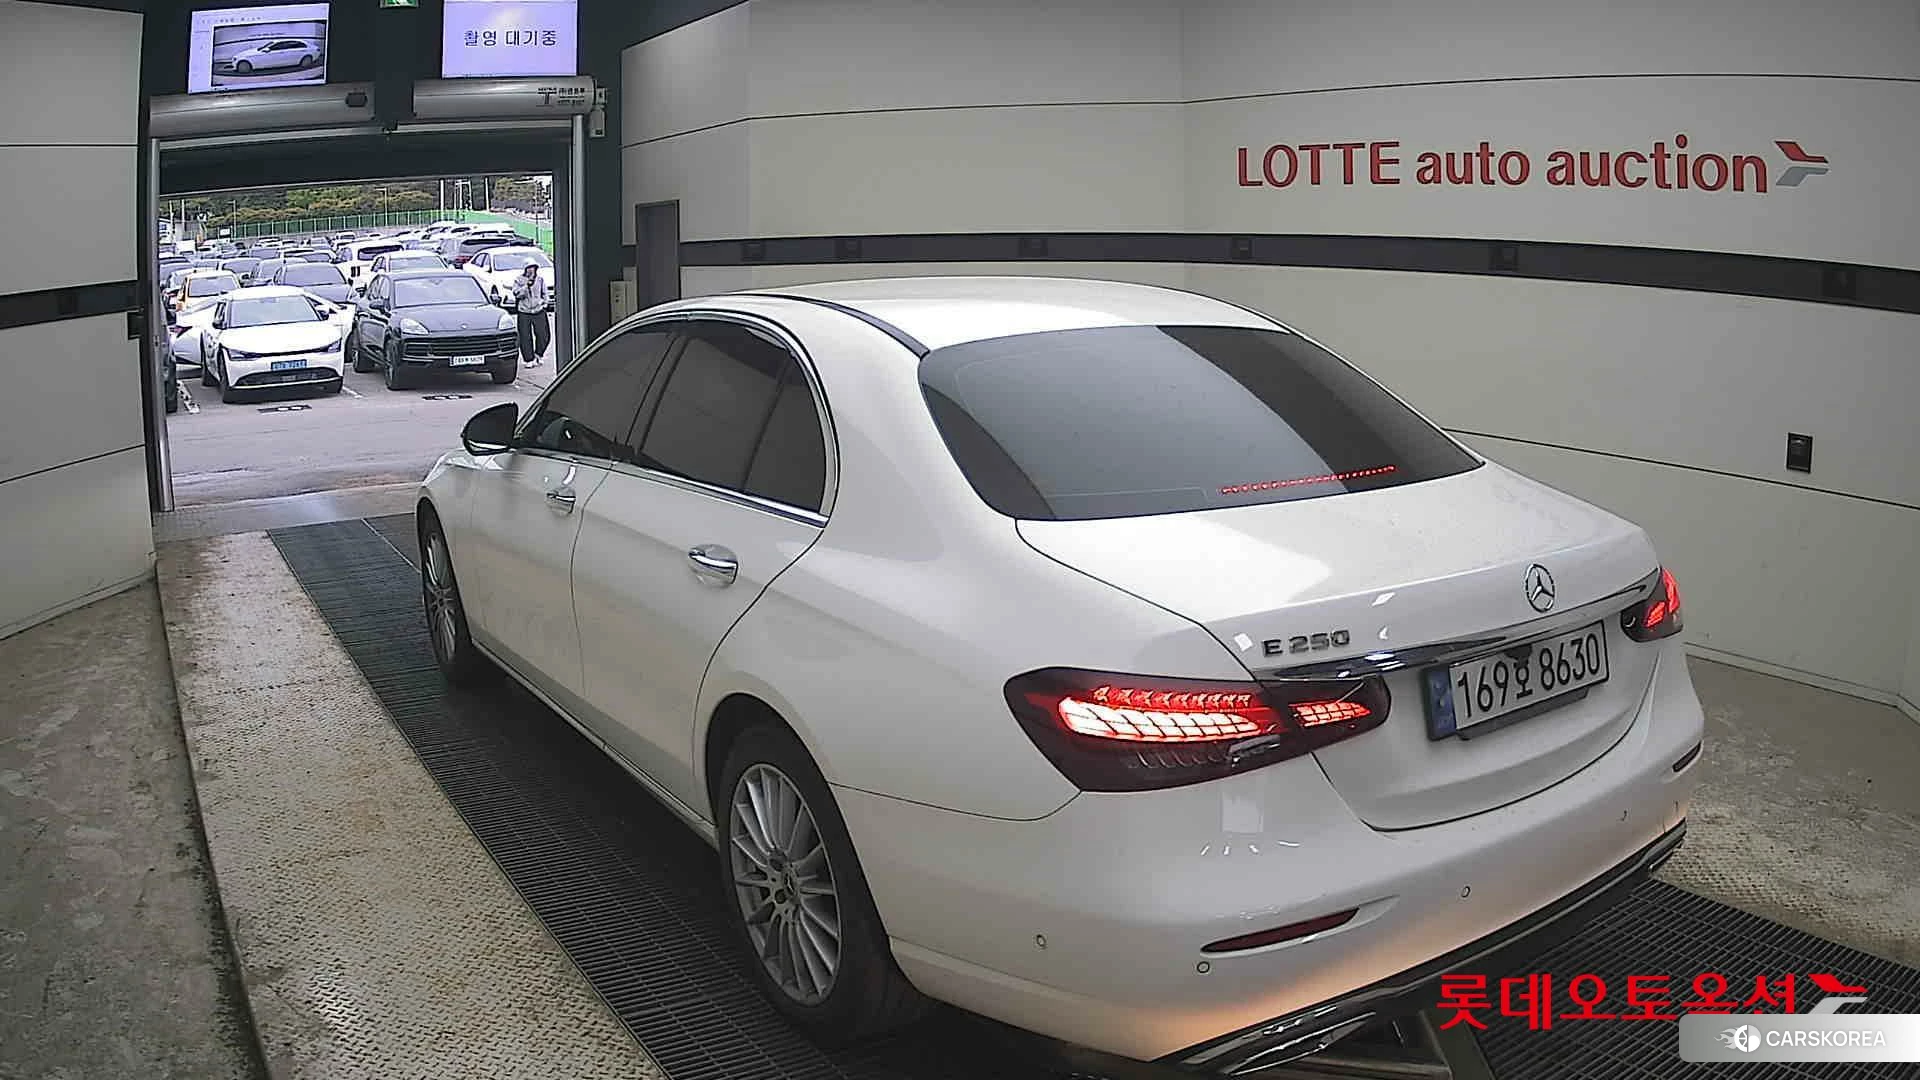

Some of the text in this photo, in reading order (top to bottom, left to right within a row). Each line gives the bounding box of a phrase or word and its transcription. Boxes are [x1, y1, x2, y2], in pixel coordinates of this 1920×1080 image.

[464, 30, 556, 47] 촬영 대기중
[1237, 134, 1768, 194] LOTTE auto auction
[1262, 629, 1350, 656] E 250
[1539, 632, 1602, 691] 8630
